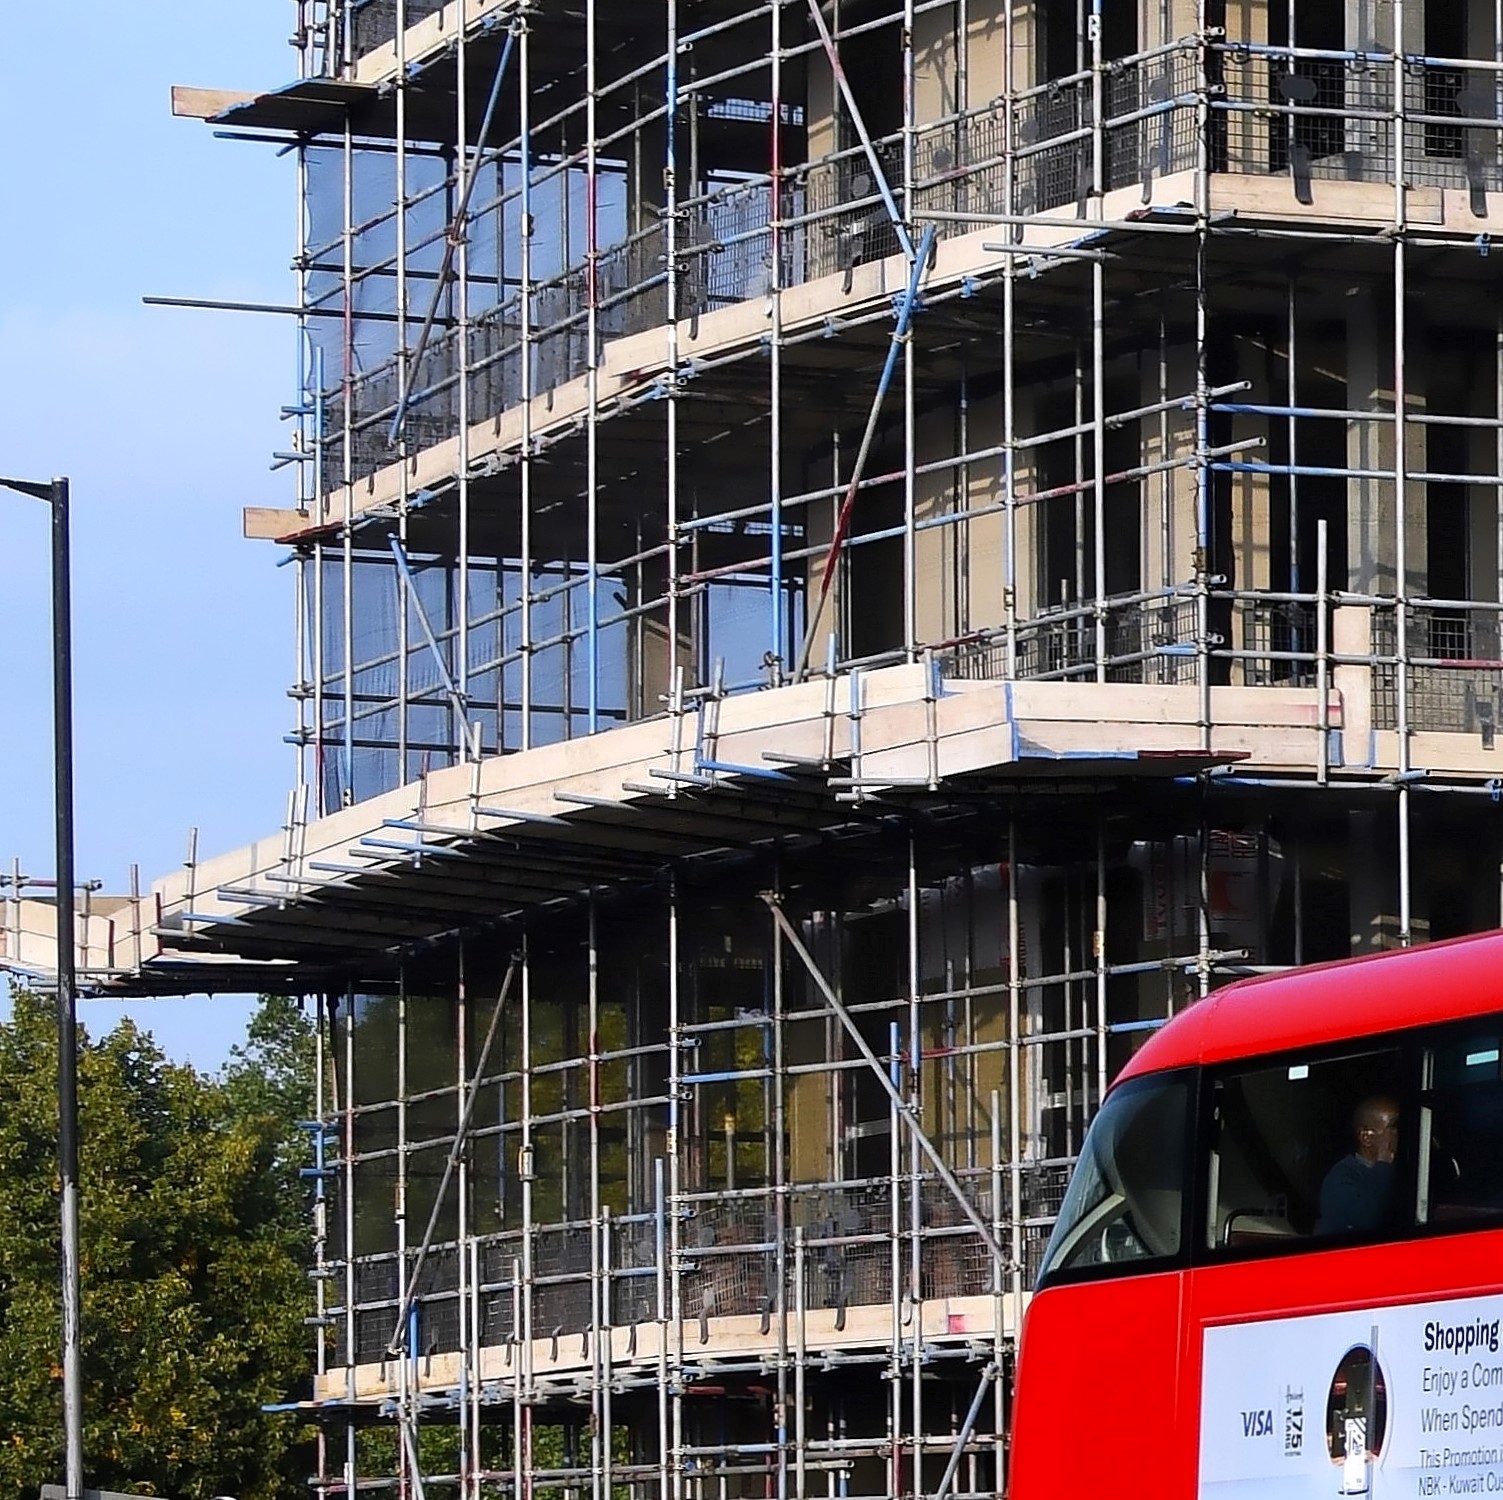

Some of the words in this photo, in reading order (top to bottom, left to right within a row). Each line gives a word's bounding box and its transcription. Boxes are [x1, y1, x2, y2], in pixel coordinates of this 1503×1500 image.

[1424, 1317, 1500, 1355] Shopping
[1423, 1367, 1457, 1397] Enjoy
[1461, 1369, 1468, 1389] a
[1240, 1410, 1273, 1437] VISA
[1421, 1407, 1458, 1432] When
[1420, 1449, 1440, 1469] This
[1443, 1445, 1497, 1468] Promotion
[1419, 1476, 1440, 1496] NBK
[1450, 1473, 1484, 1494] Kuwait
